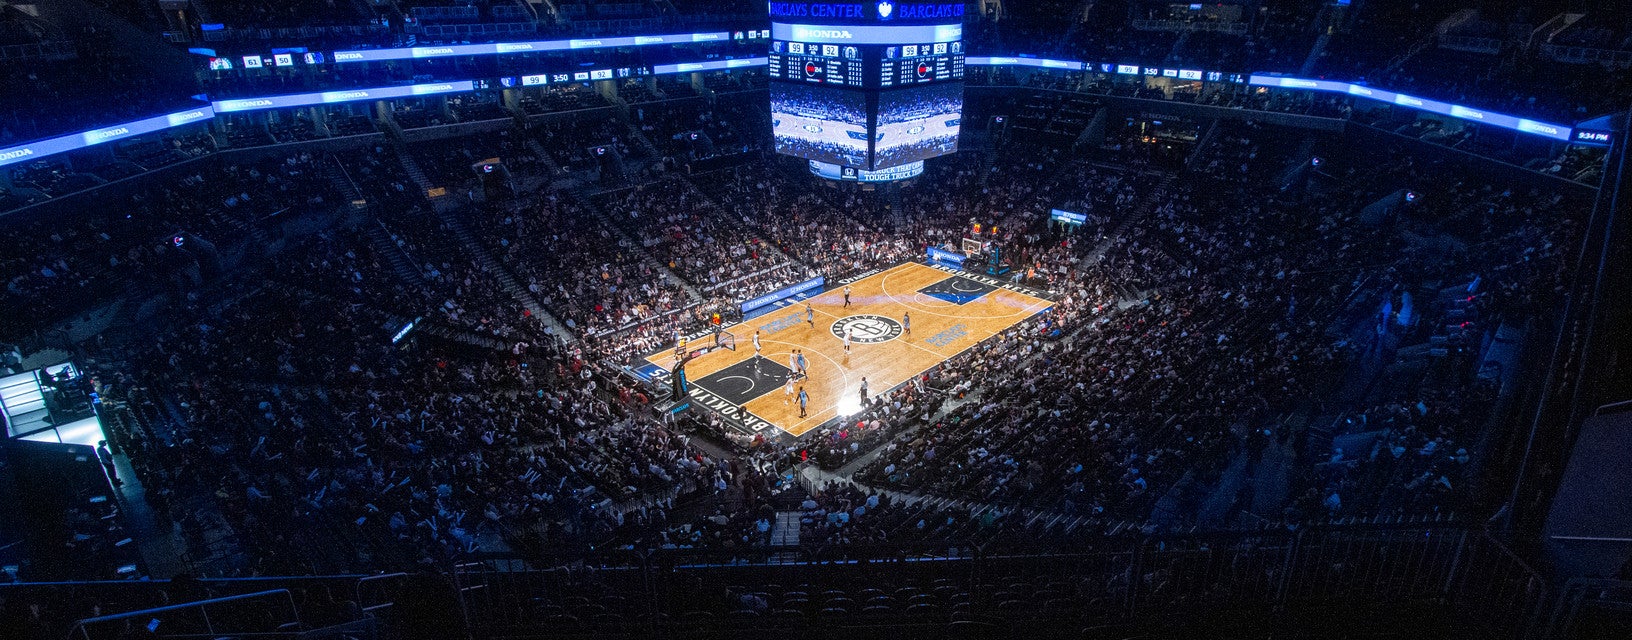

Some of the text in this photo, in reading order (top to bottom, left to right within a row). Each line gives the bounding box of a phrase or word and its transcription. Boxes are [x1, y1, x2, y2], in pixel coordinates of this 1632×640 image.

[771, 3, 864, 18] BARCLAYS CENTER
[900, 4, 952, 18] BARCLAYS
[807, 30, 852, 38] HONDA
[792, 44, 800, 52] 99
[826, 46, 835, 55] 92
[906, 47, 914, 55] 99
[178, 110, 204, 121] HONDA
[97, 127, 129, 139] HONDA
[1578, 132, 1594, 140] 9:34
[940, 252, 960, 261] HONDA
[931, 263, 998, 285] BROOKLYN
[1002, 283, 1039, 296] NETS
[796, 281, 818, 292] HONDA
[755, 294, 778, 306] HONDA
